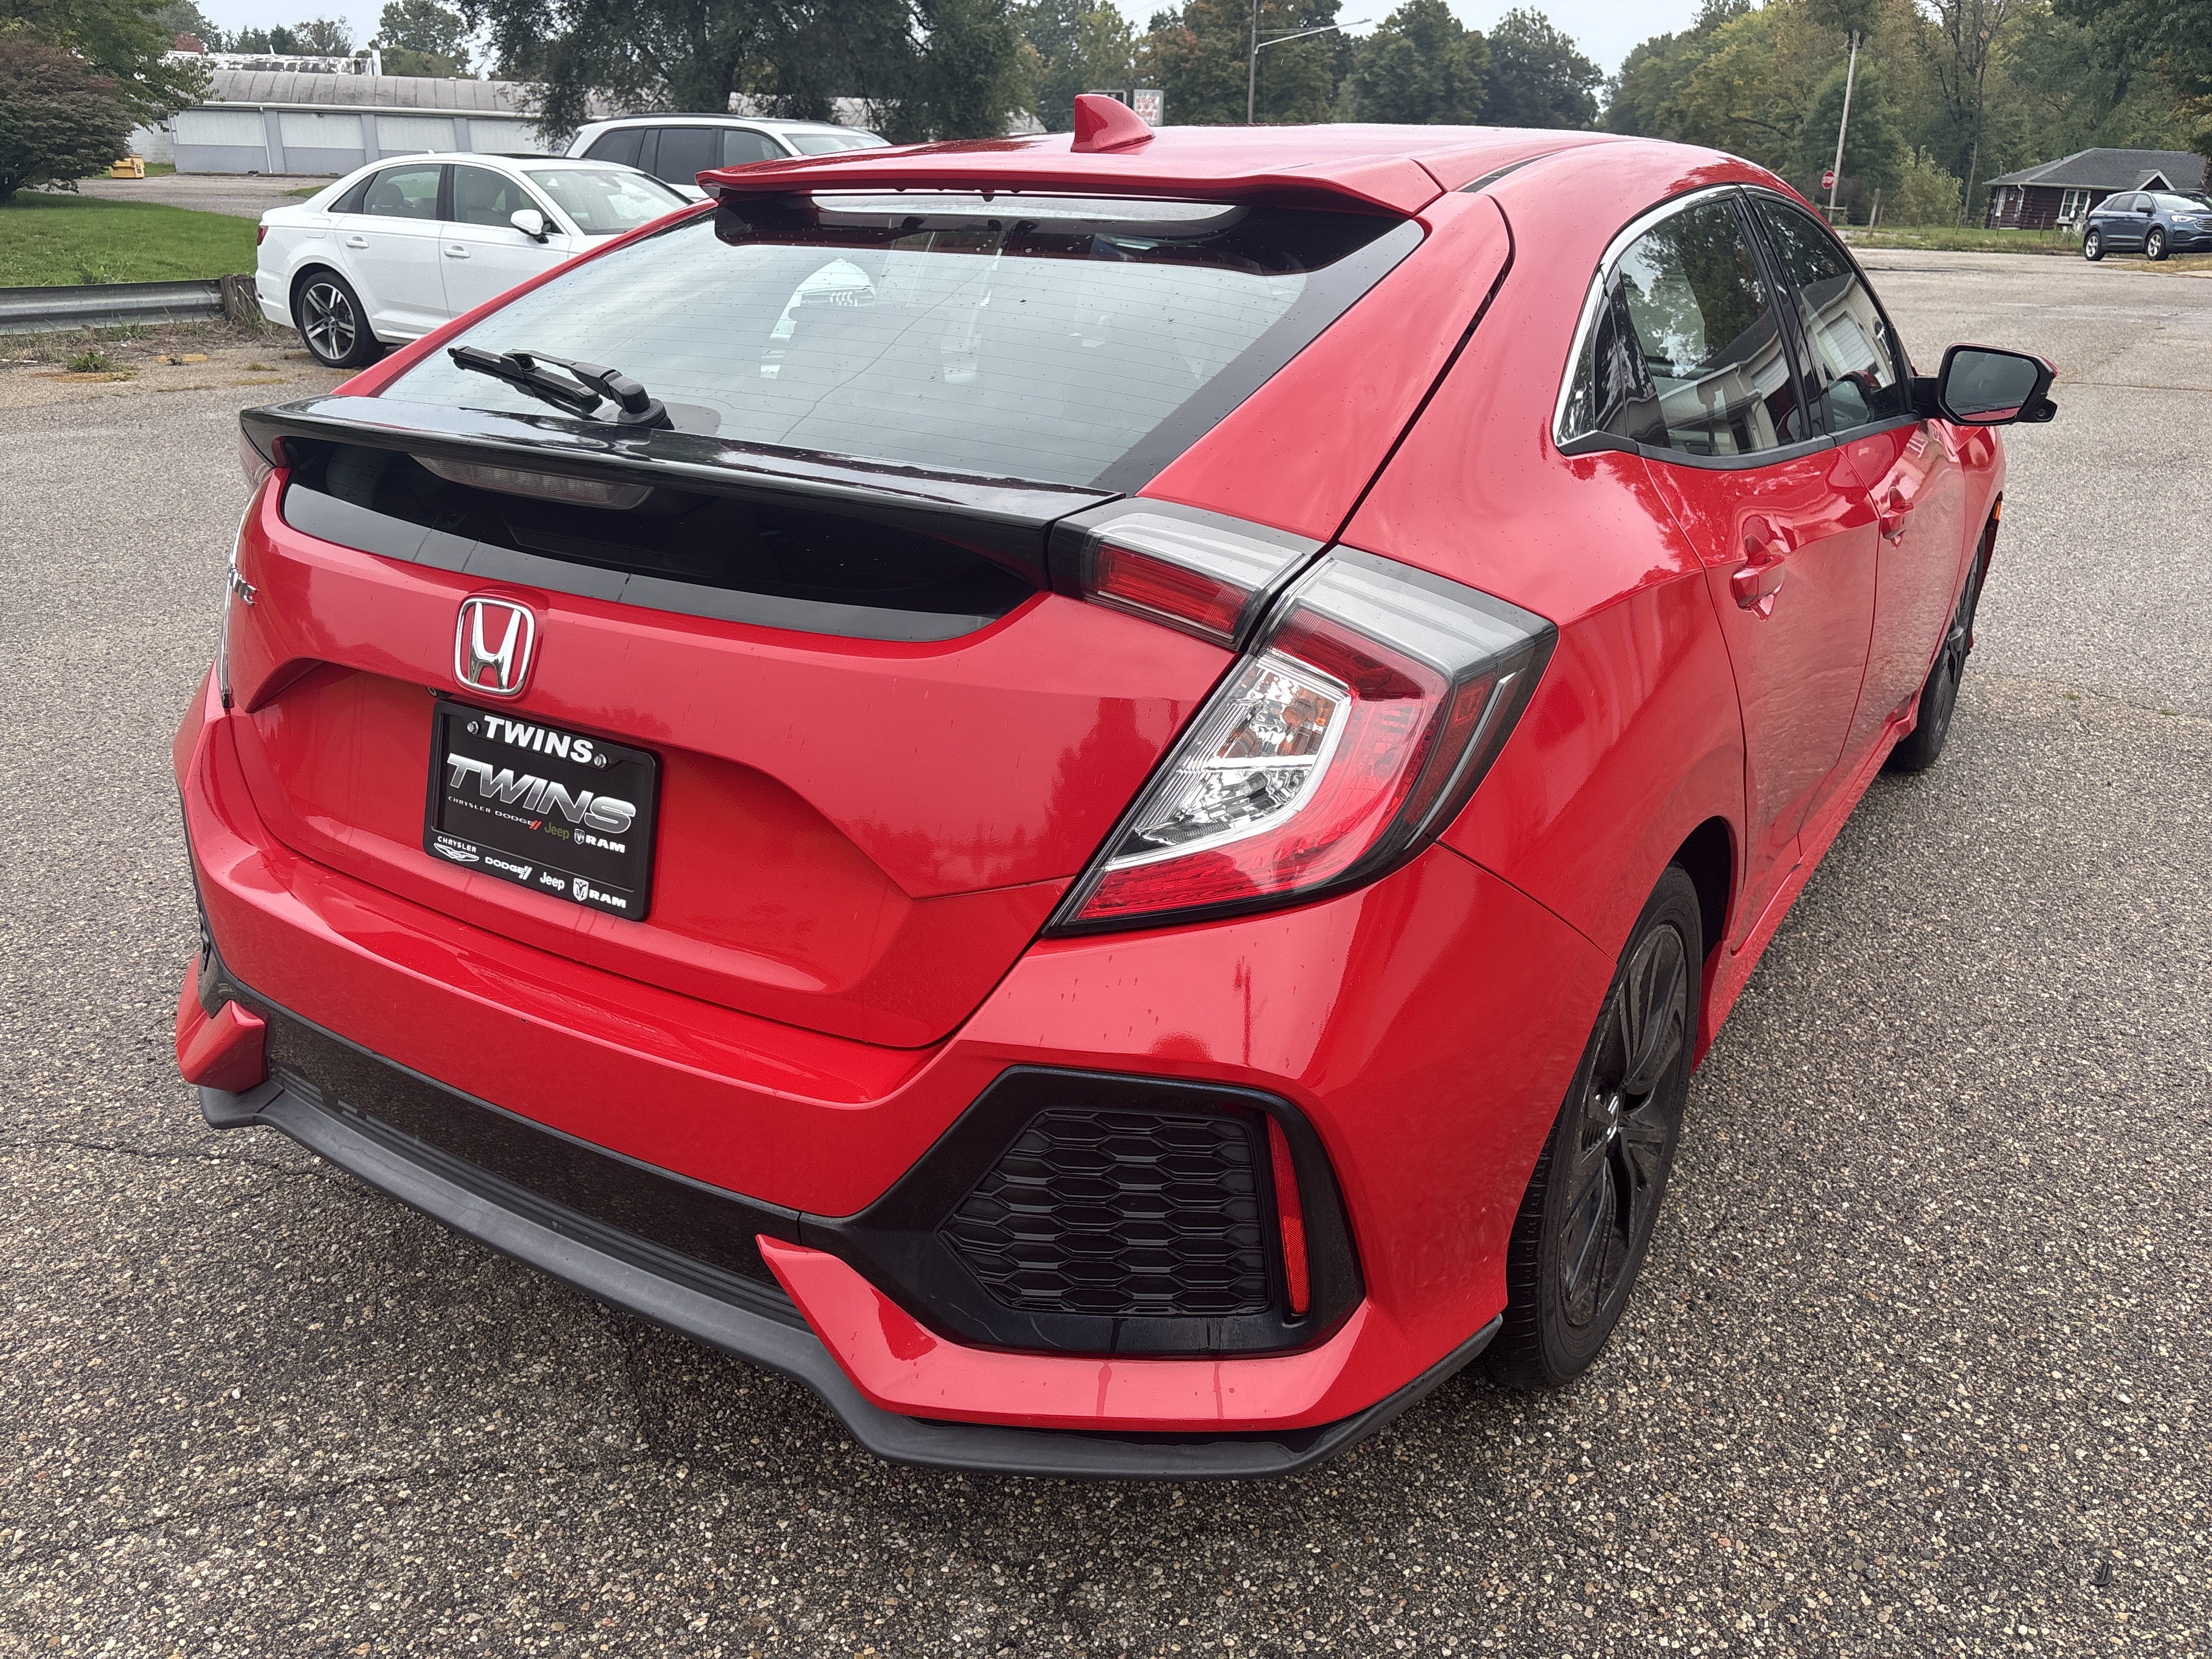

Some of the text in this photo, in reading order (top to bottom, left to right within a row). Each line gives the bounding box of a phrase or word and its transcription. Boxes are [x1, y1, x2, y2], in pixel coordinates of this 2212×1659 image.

[483, 715, 594, 763] TWINS
[447, 753, 636, 834] TWINS
[448, 796, 625, 853] CHRYSLER DODGE Jeep RAM
[438, 836, 627, 909] CHRYSLER DODGE Jeep RAM
